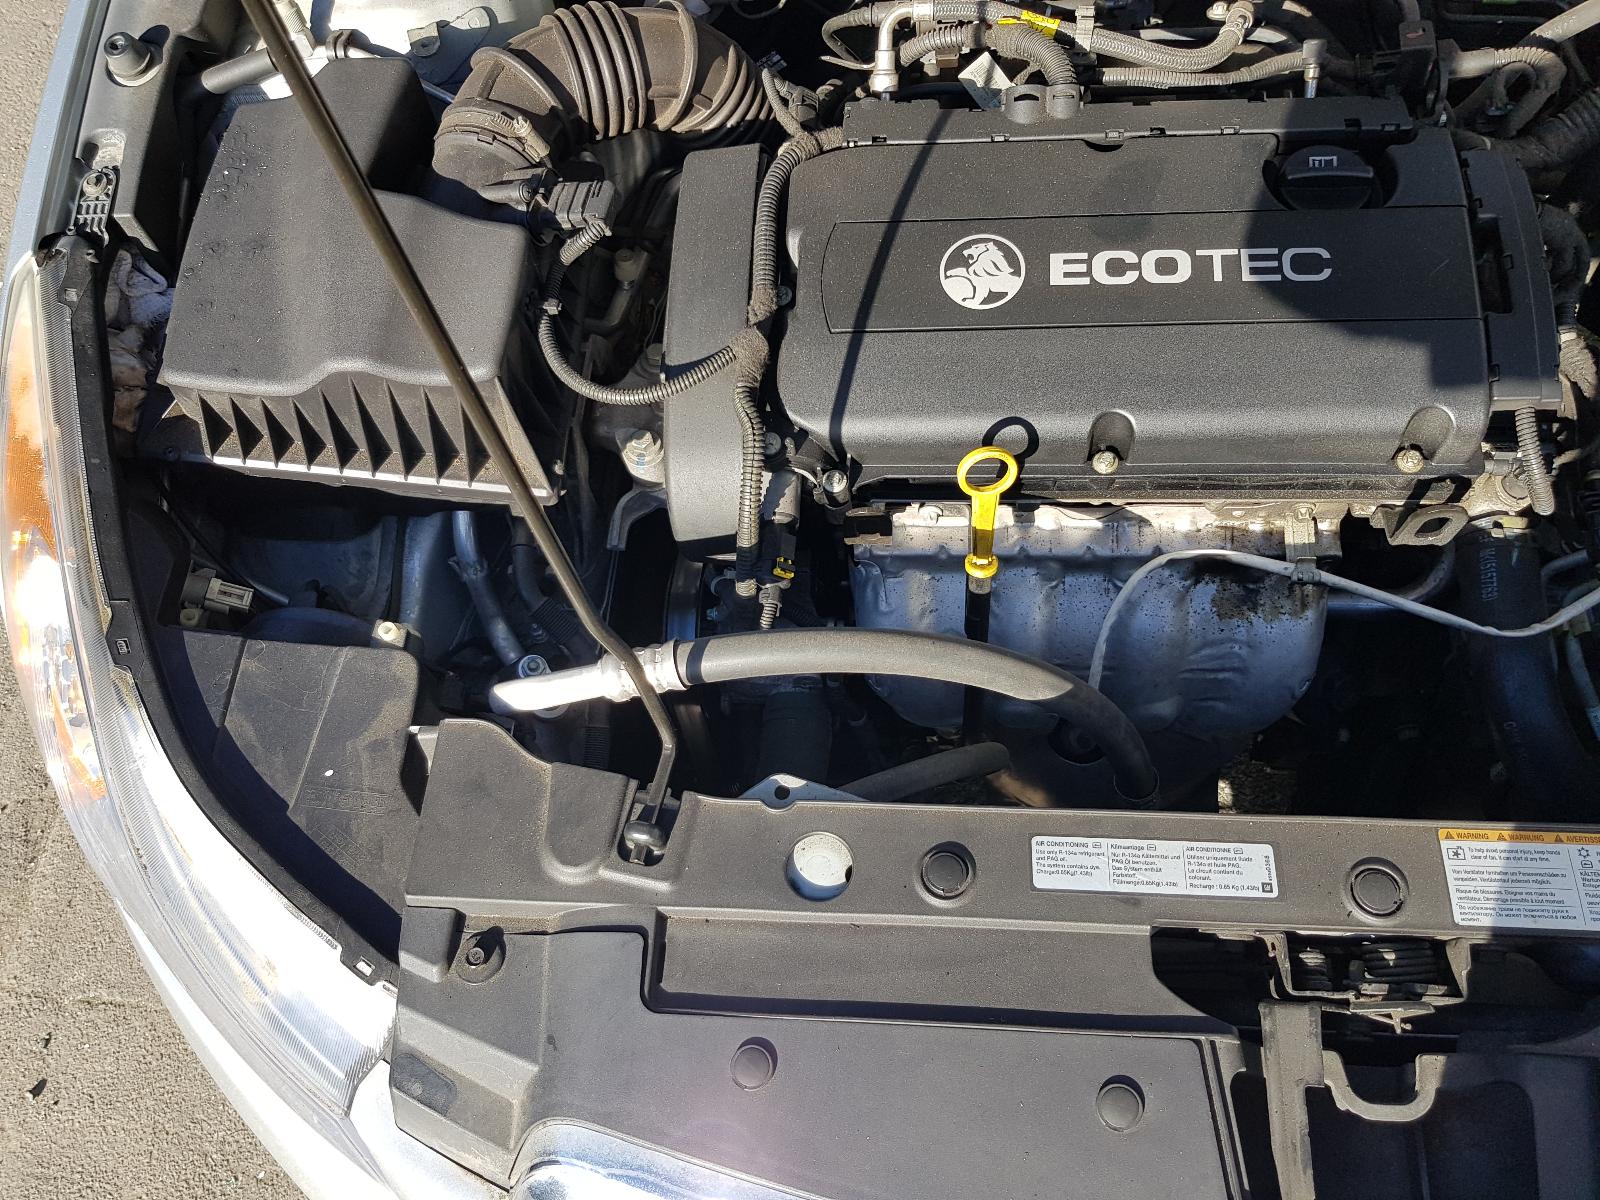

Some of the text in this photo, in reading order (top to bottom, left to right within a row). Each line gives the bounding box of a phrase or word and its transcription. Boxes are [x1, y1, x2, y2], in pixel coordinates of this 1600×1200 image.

[1049, 247, 1332, 286] ECOTEC
[1456, 832, 1489, 840] WARNING
[1508, 833, 1545, 841] WARNUNG
